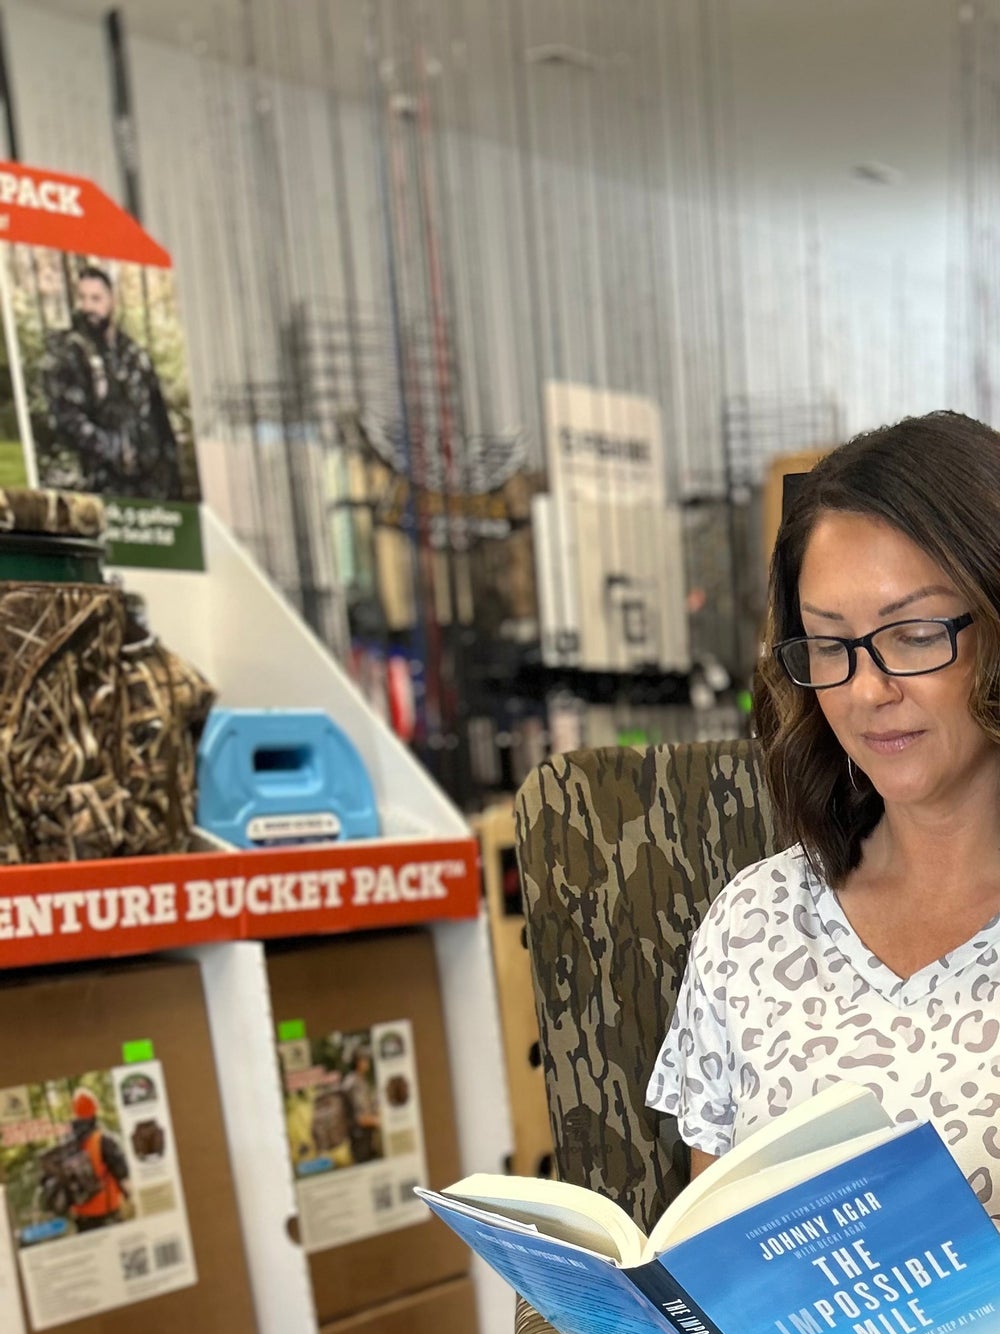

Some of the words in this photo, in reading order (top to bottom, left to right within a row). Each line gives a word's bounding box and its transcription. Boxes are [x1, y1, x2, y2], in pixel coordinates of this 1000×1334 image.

[0, 172, 84, 217] PACK
[185, 869, 347, 921] BUCKET
[759, 1215, 829, 1261] JOHNNY
[832, 1191, 882, 1228] AGAR
[793, 1241, 817, 1259] WITH
[843, 1221, 867, 1238] AGAR
[812, 1238, 881, 1287] THE
[662, 1298, 691, 1317] THE
[975, 1302, 997, 1318] TIME
